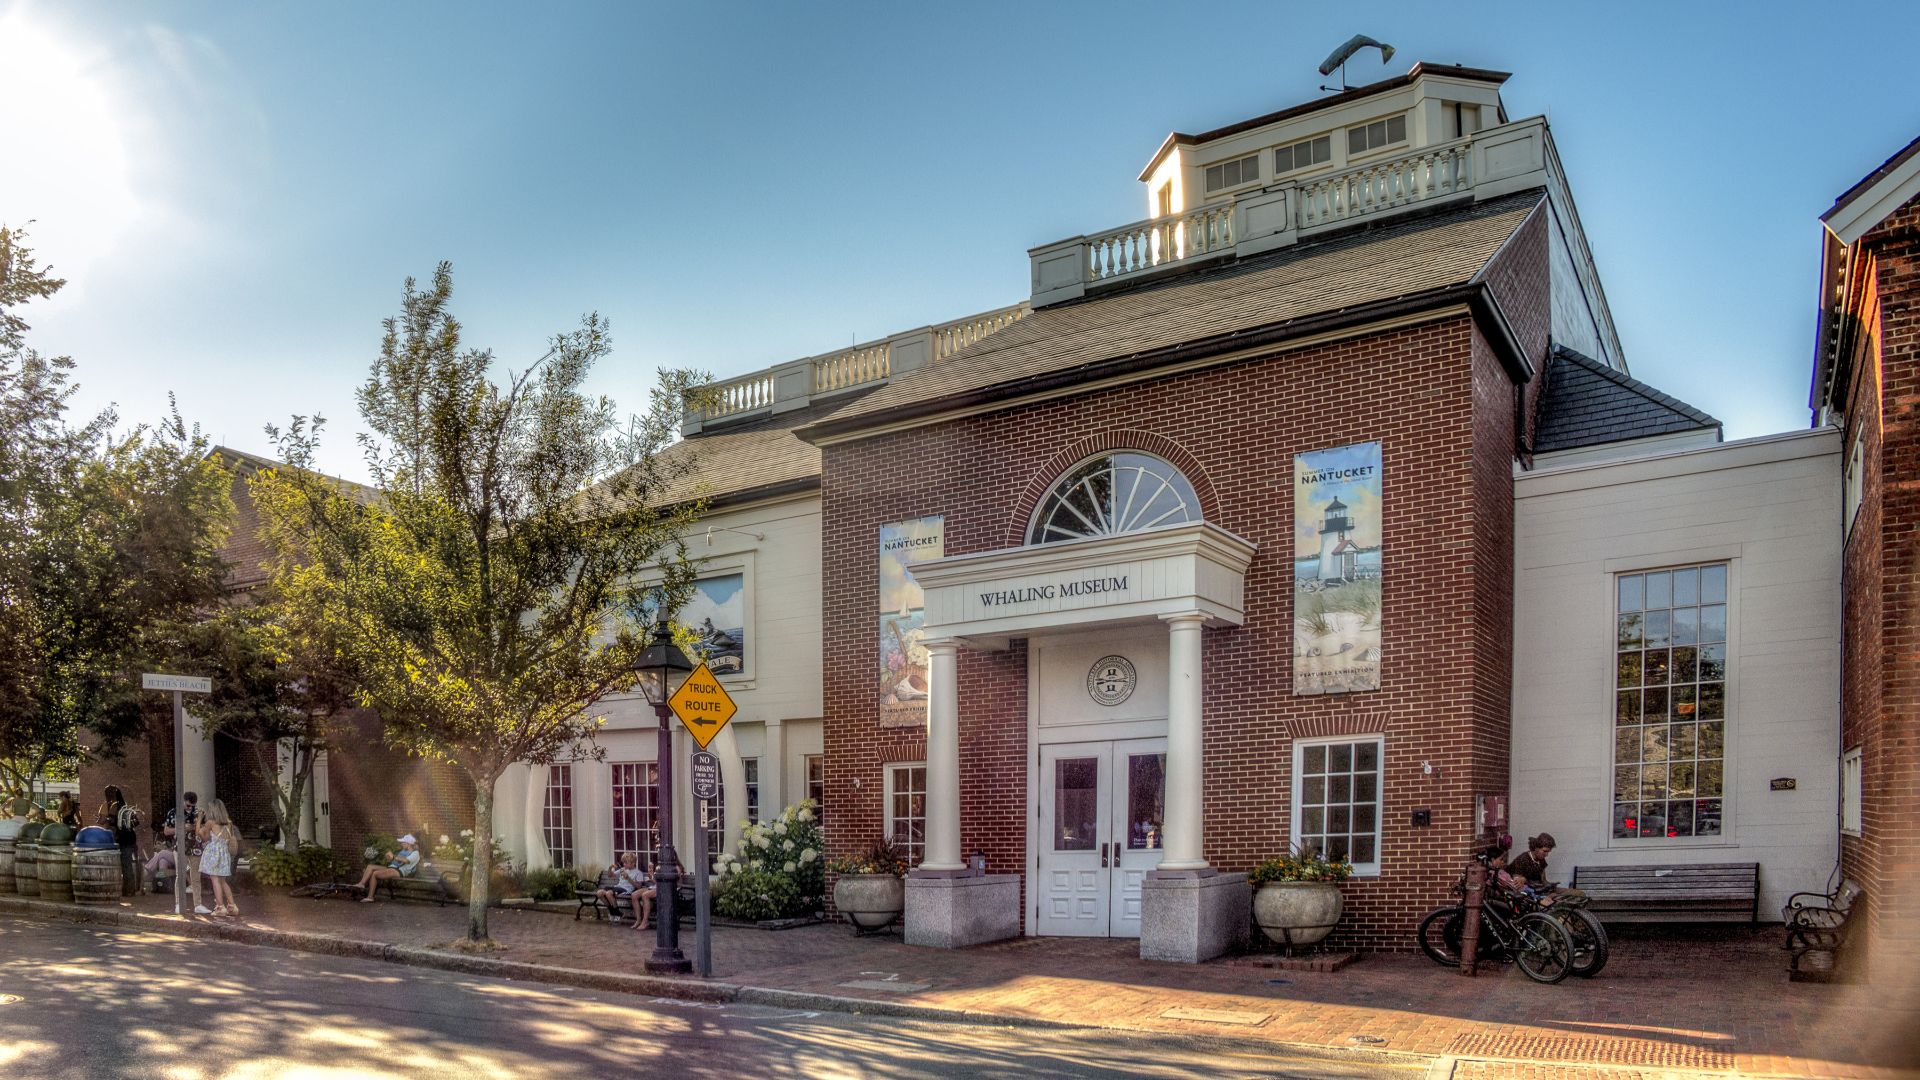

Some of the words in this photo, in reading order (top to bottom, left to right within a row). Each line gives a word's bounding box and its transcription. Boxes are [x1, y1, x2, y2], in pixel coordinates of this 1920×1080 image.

[1301, 466, 1374, 485] NANTUCKET
[884, 536, 938, 551] NANTUCKET
[980, 585, 1055, 607] WHALING
[1060, 576, 1128, 598] MUSEUM
[148, 680, 178, 688] JETTIES
[180, 681, 206, 690] BEACH
[689, 683, 717, 694] TRUCK
[685, 700, 721, 712] ROUTE
[699, 756, 710, 764] NO
[694, 764, 715, 773] PARKING
